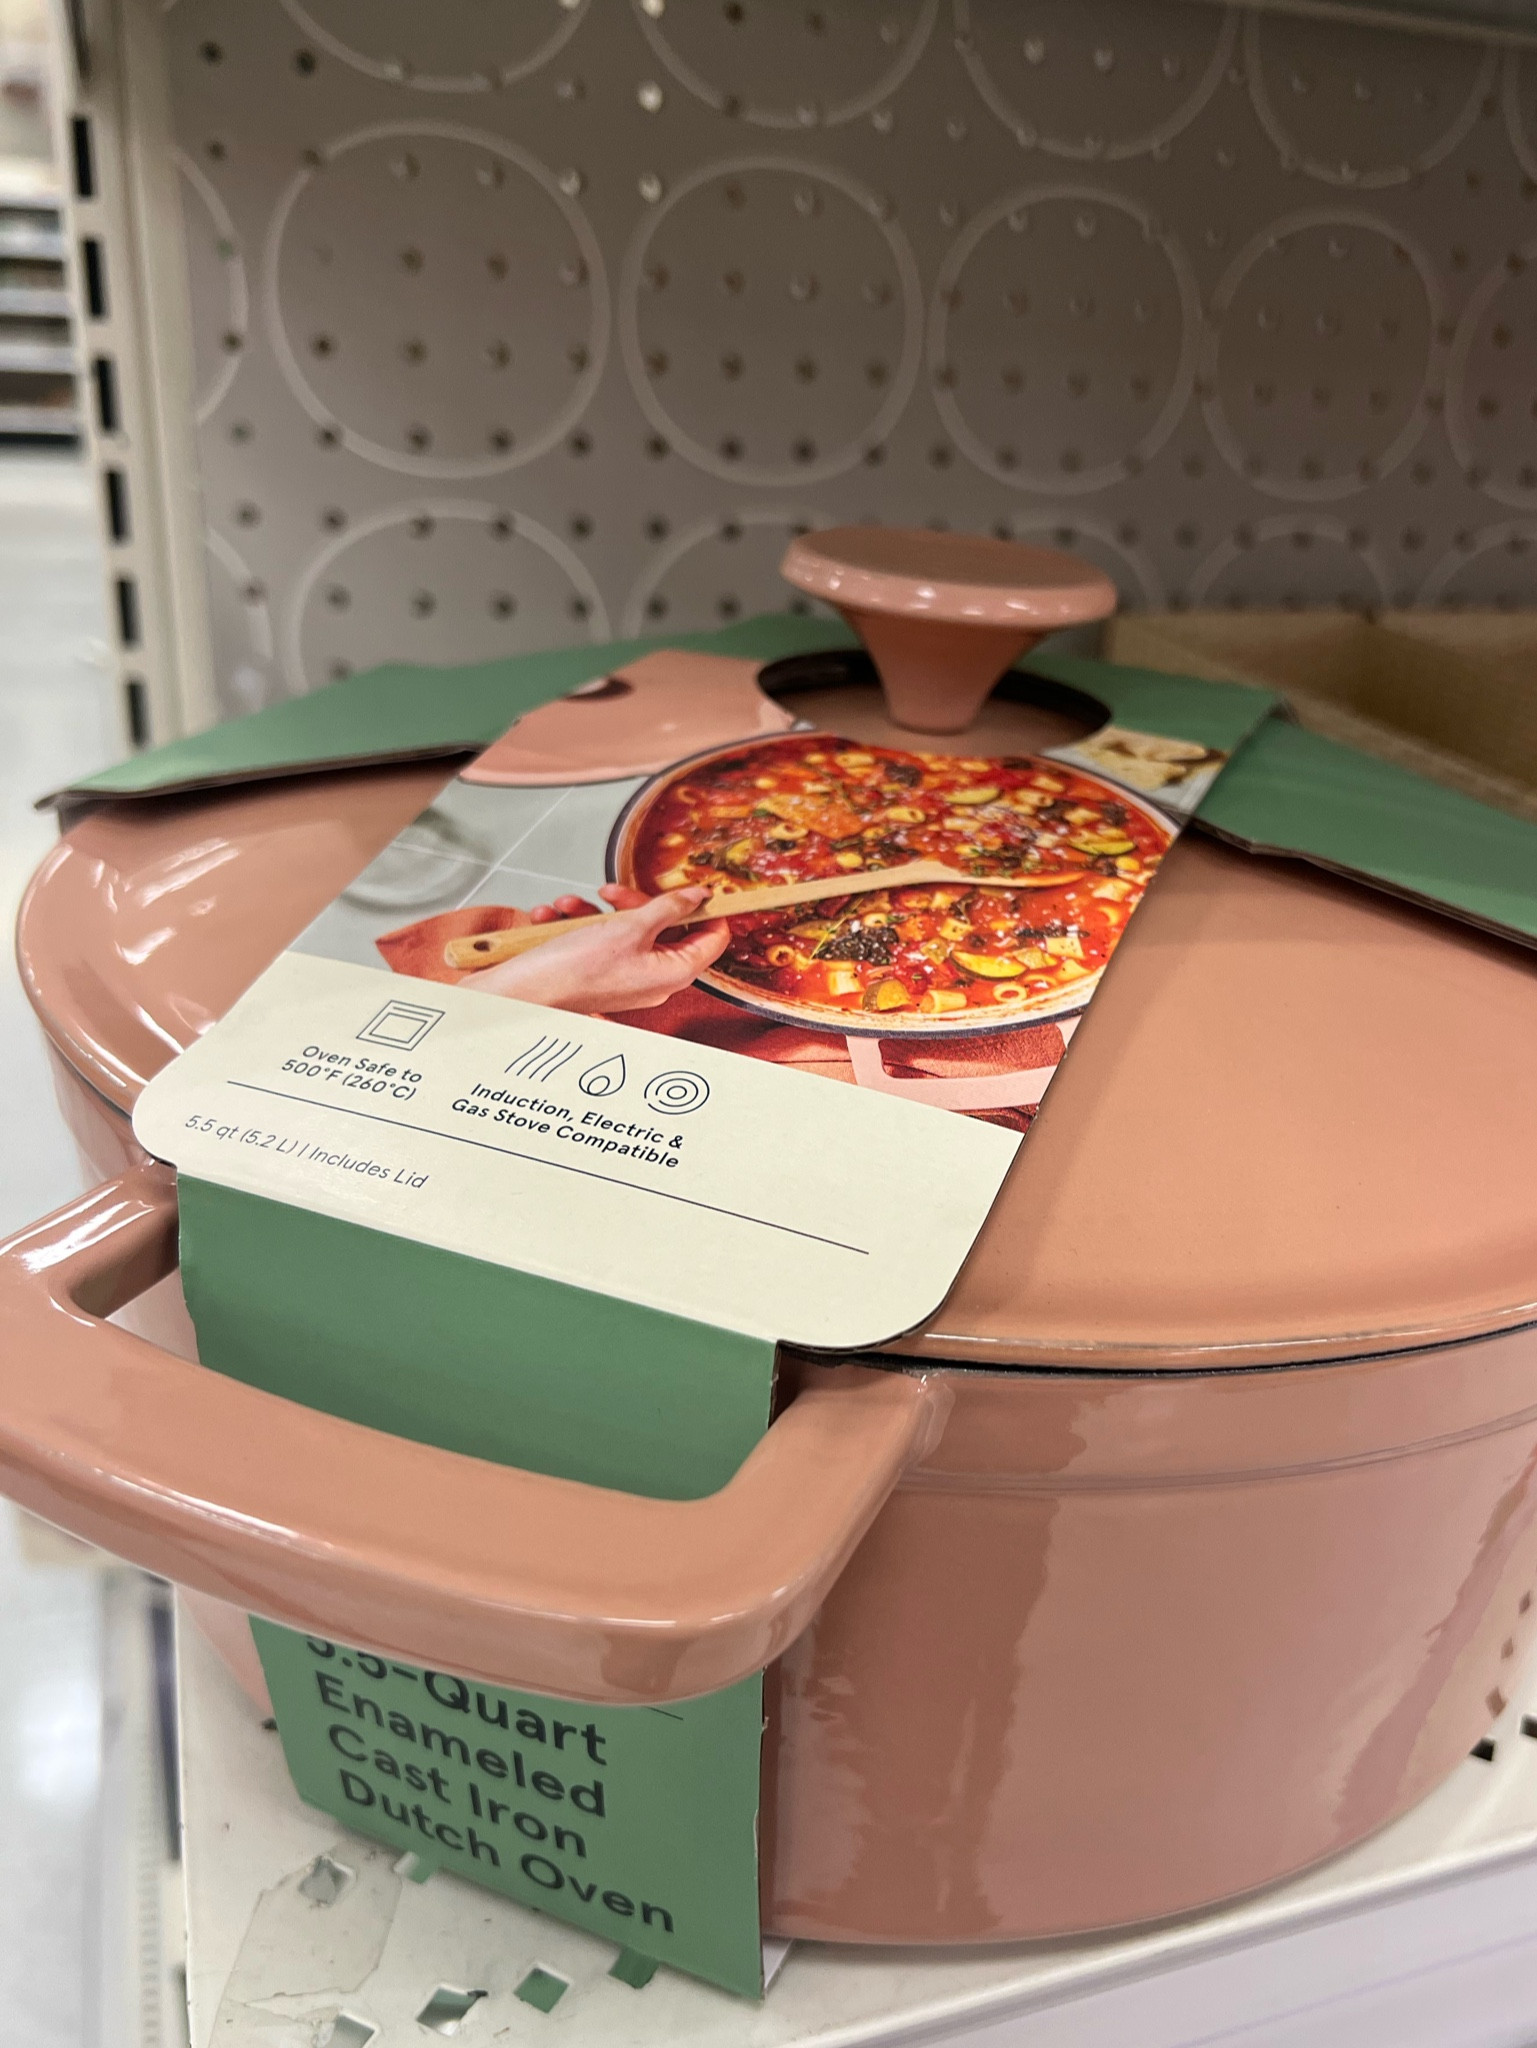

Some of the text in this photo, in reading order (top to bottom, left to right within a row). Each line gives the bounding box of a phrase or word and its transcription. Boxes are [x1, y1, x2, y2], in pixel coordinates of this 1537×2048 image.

[281, 1058, 417, 1101] 500°F (260°C)
[302, 1045, 423, 1083] Oven Safe to
[185, 1114, 214, 1133] 5.5
[216, 1124, 237, 1142] qt
[240, 1128, 275, 1149] (5.2
[275, 1138, 298, 1154] L)
[309, 1146, 391, 1180] Includes
[393, 1169, 429, 1189] Lid
[451, 1098, 679, 1168] Gas Stove Compatible
[470, 1083, 684, 1149] Induction, Electric &
[315, 1670, 607, 1818] Enameled
[328, 1723, 588, 1858] Cast Iron
[339, 1768, 675, 1933] Dutch Oven
